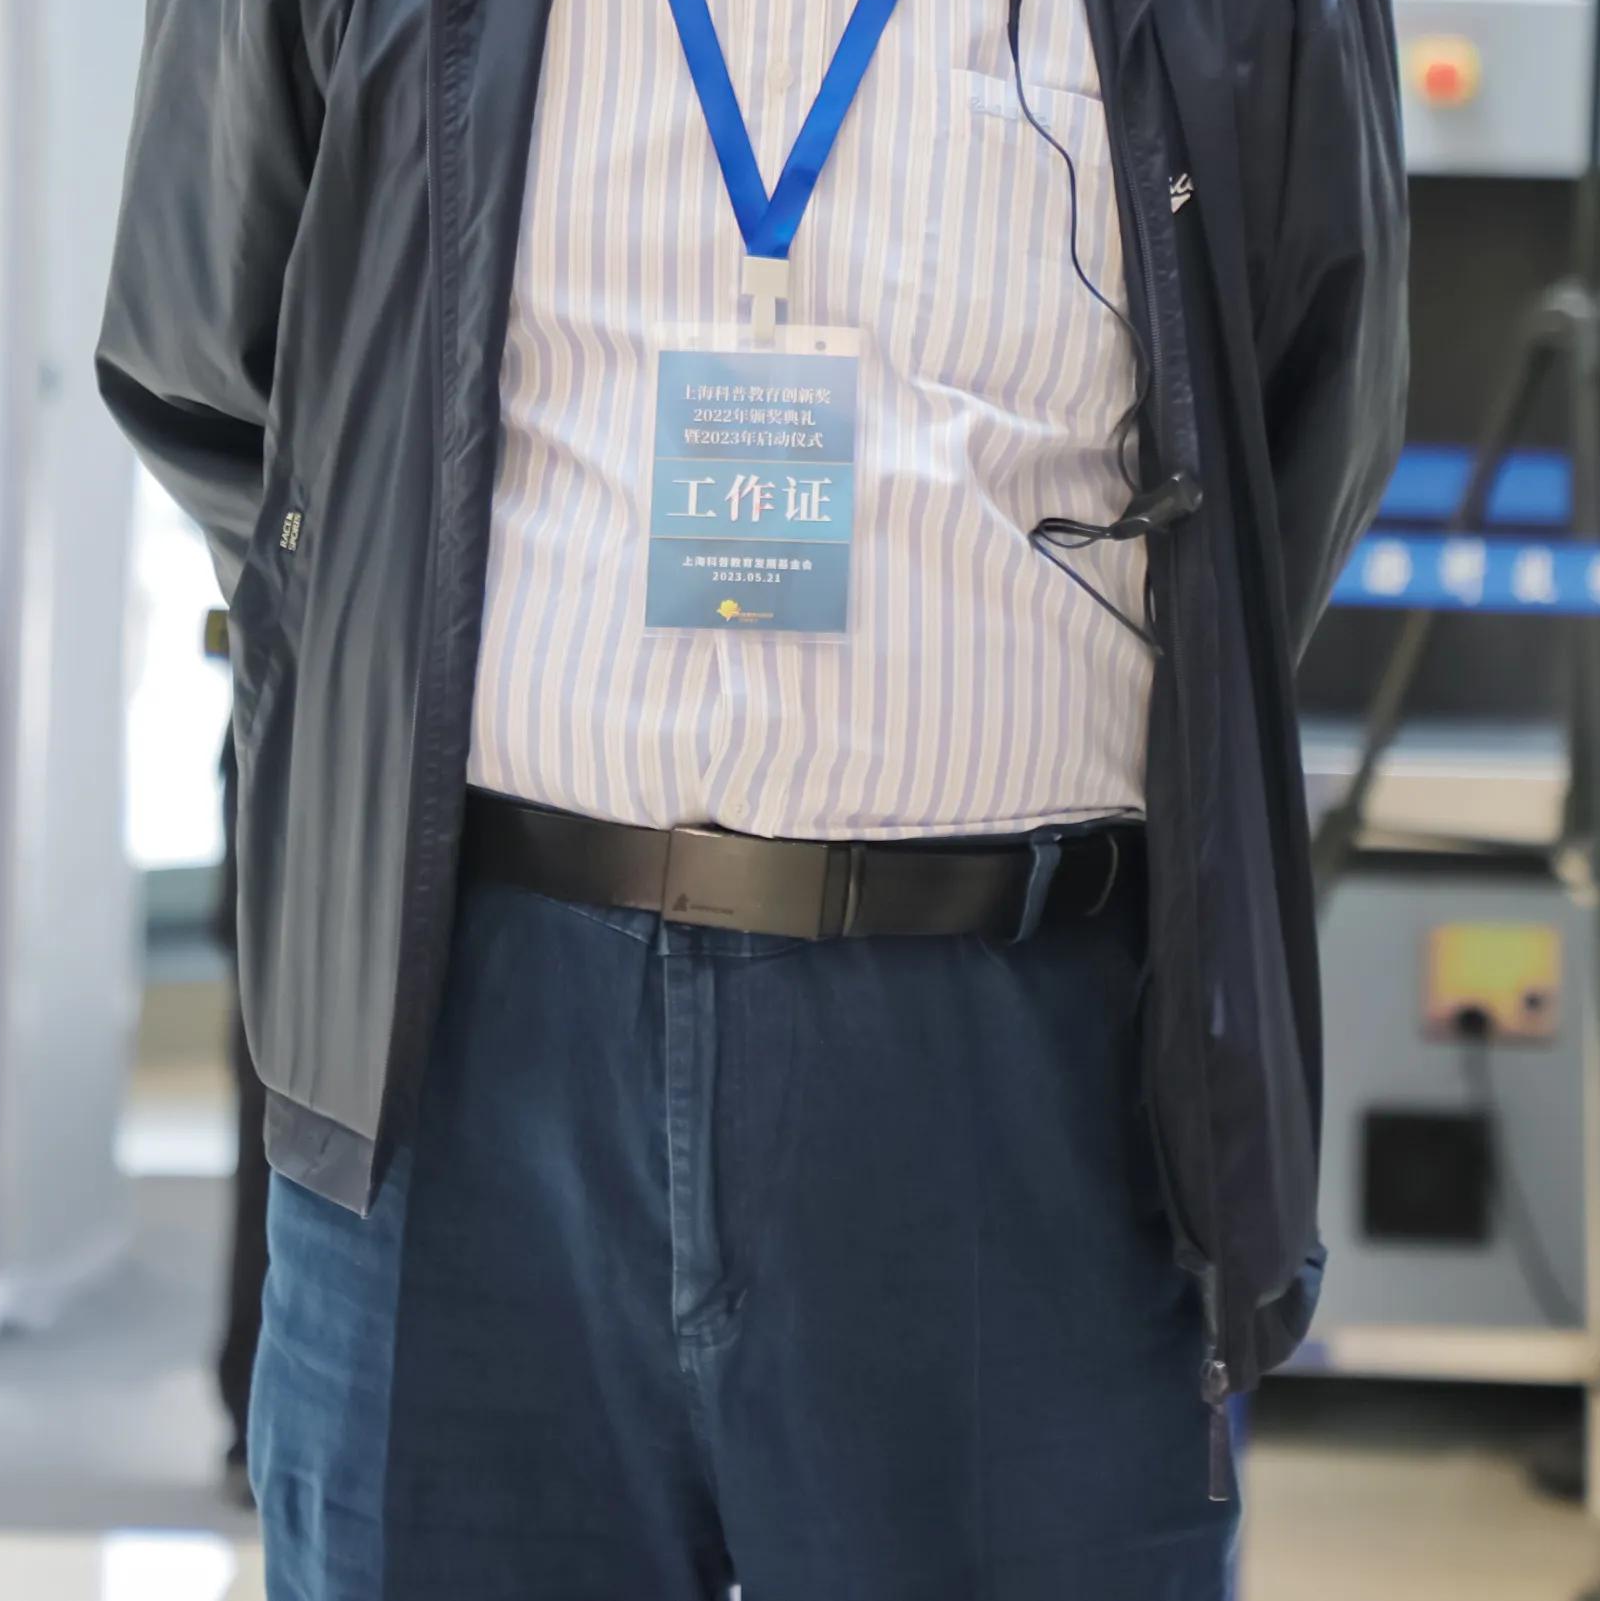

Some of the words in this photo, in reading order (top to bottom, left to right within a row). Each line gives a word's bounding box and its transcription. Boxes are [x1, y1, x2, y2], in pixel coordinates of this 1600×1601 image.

[683, 383, 831, 405] 上海科普教育创新奖
[693, 408, 816, 427] 2022年颁奖典礼
[684, 428, 824, 449] 暨2023年启动仪式
[666, 475, 832, 522] 工作证
[711, 570, 781, 583] 2023.05.21
